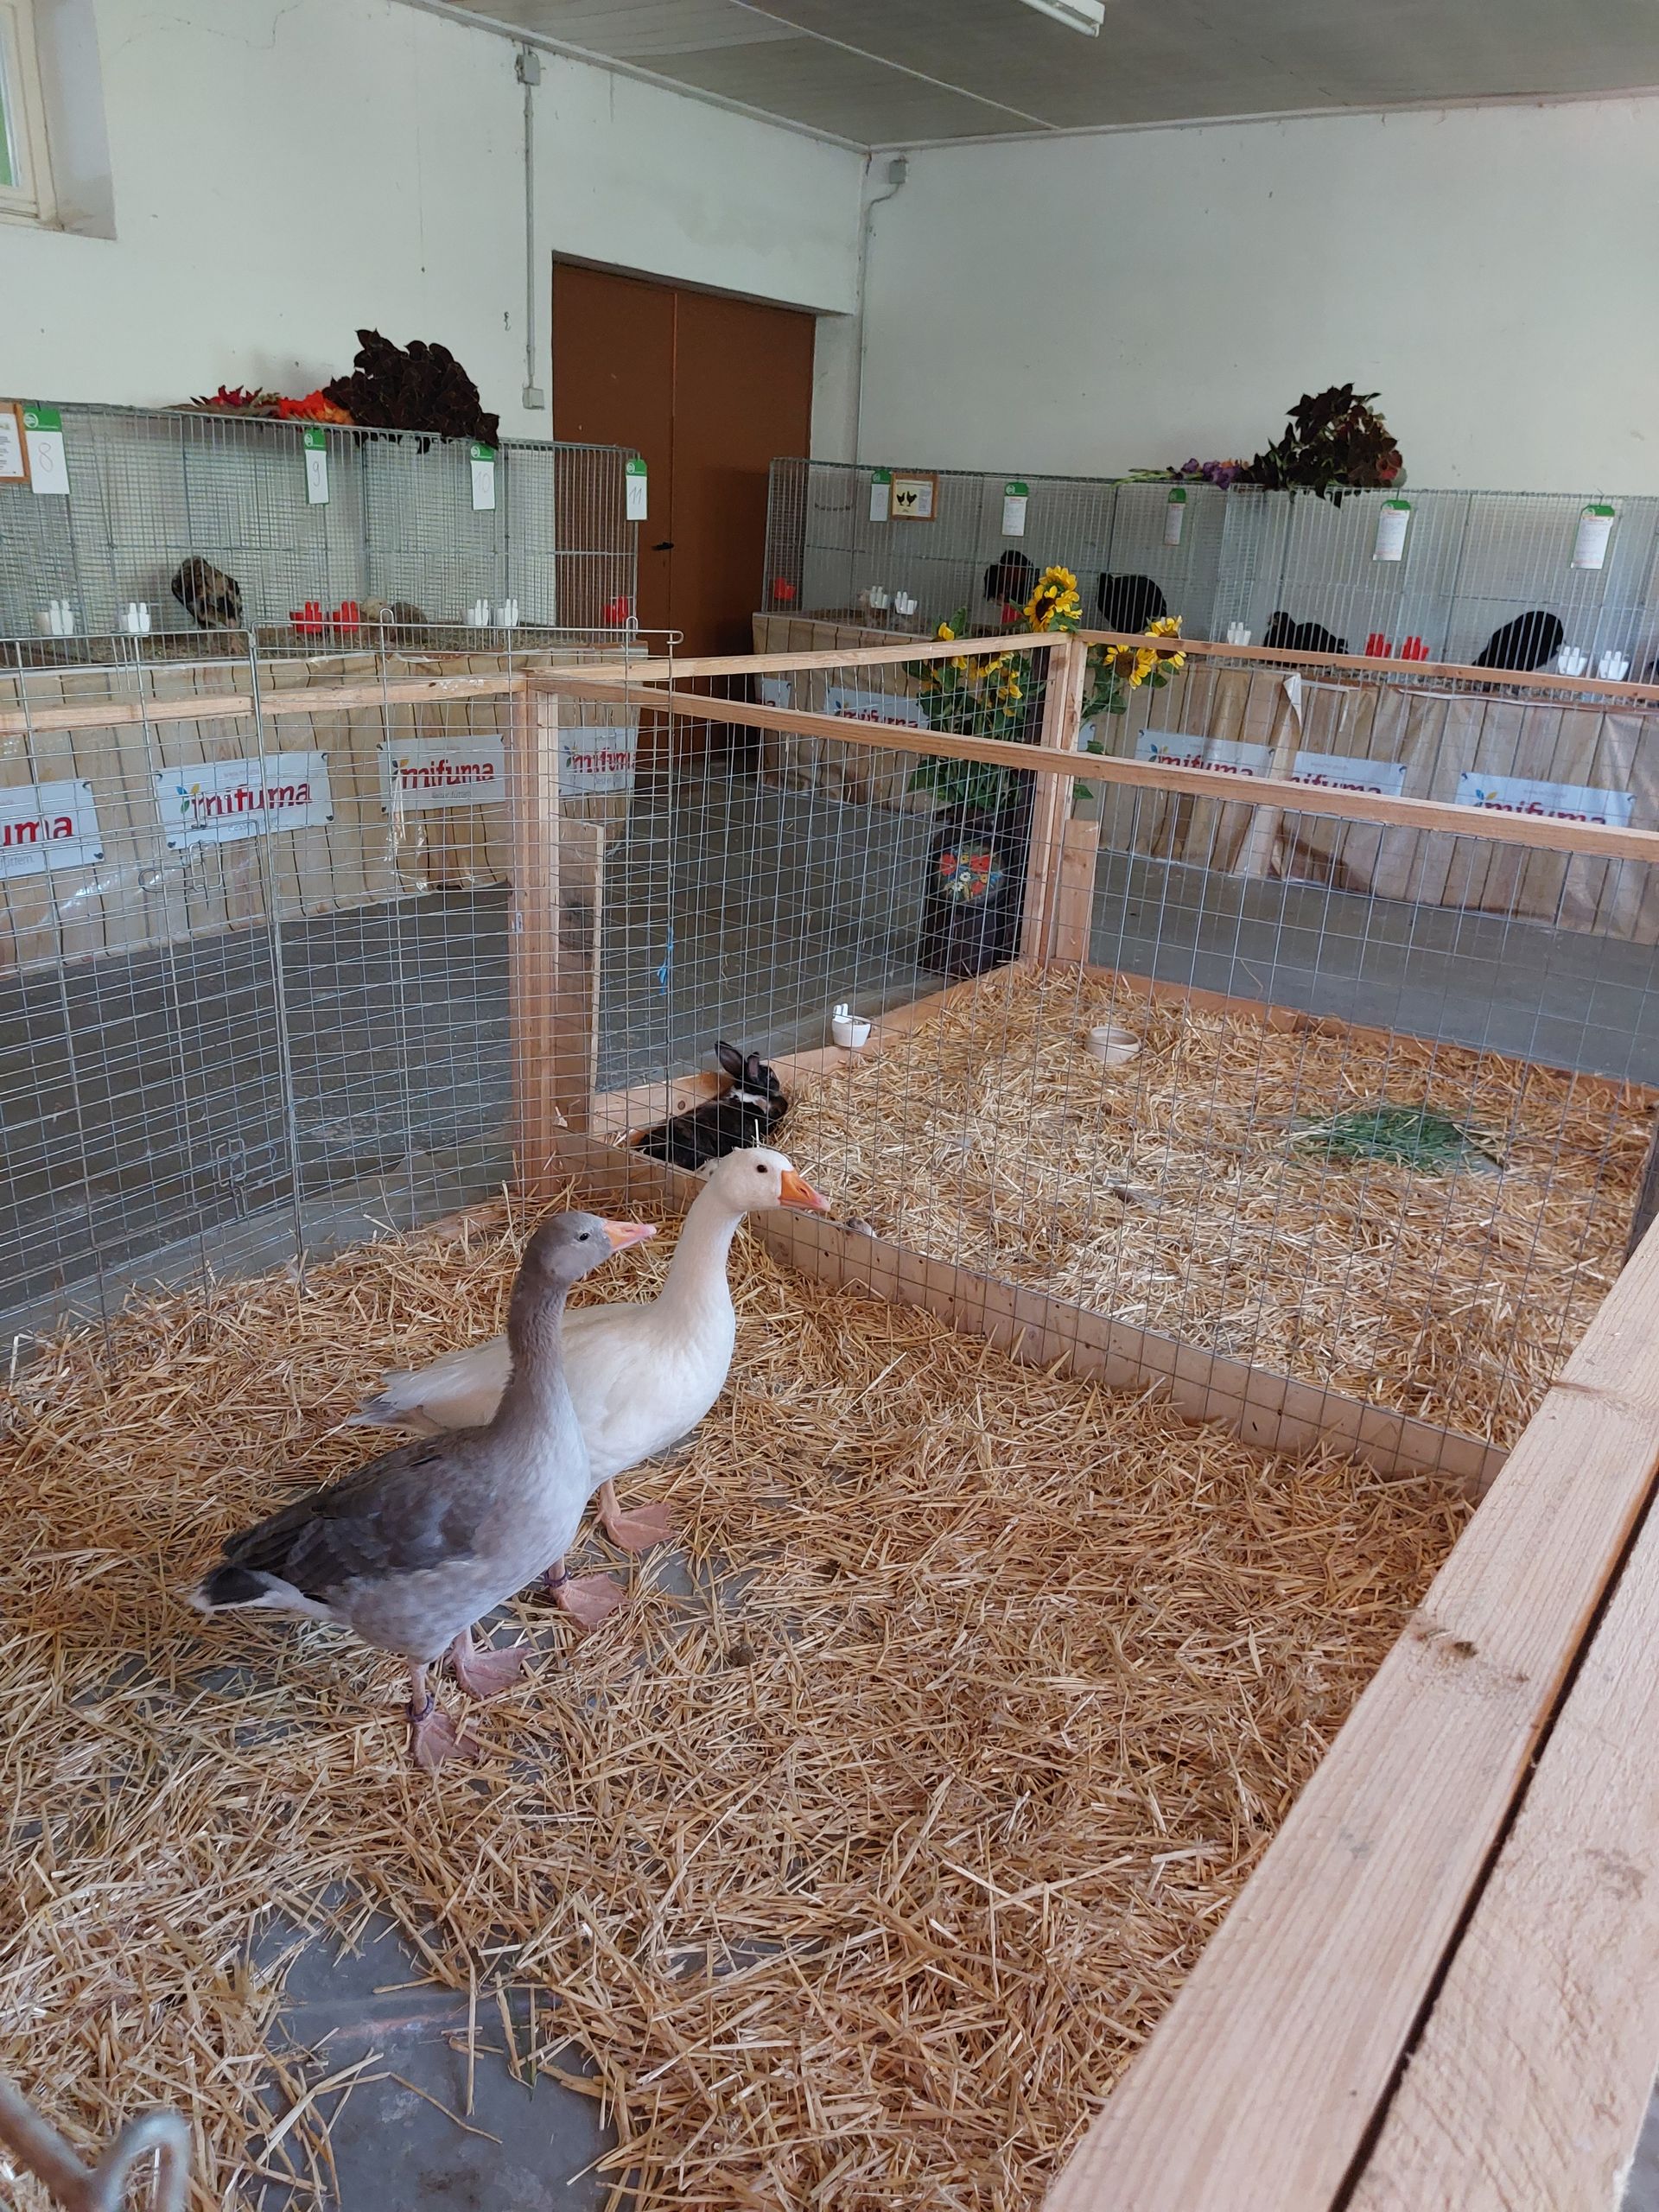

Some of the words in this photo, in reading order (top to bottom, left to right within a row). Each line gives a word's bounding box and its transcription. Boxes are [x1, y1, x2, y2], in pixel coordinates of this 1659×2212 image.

[39, 442, 54, 474] 8
[313, 461, 321, 486] 9
[628, 486, 642, 505] 11
[572, 747, 635, 773] mifum
[400, 759, 495, 790] mifuma
[191, 783, 313, 820] mifuma
